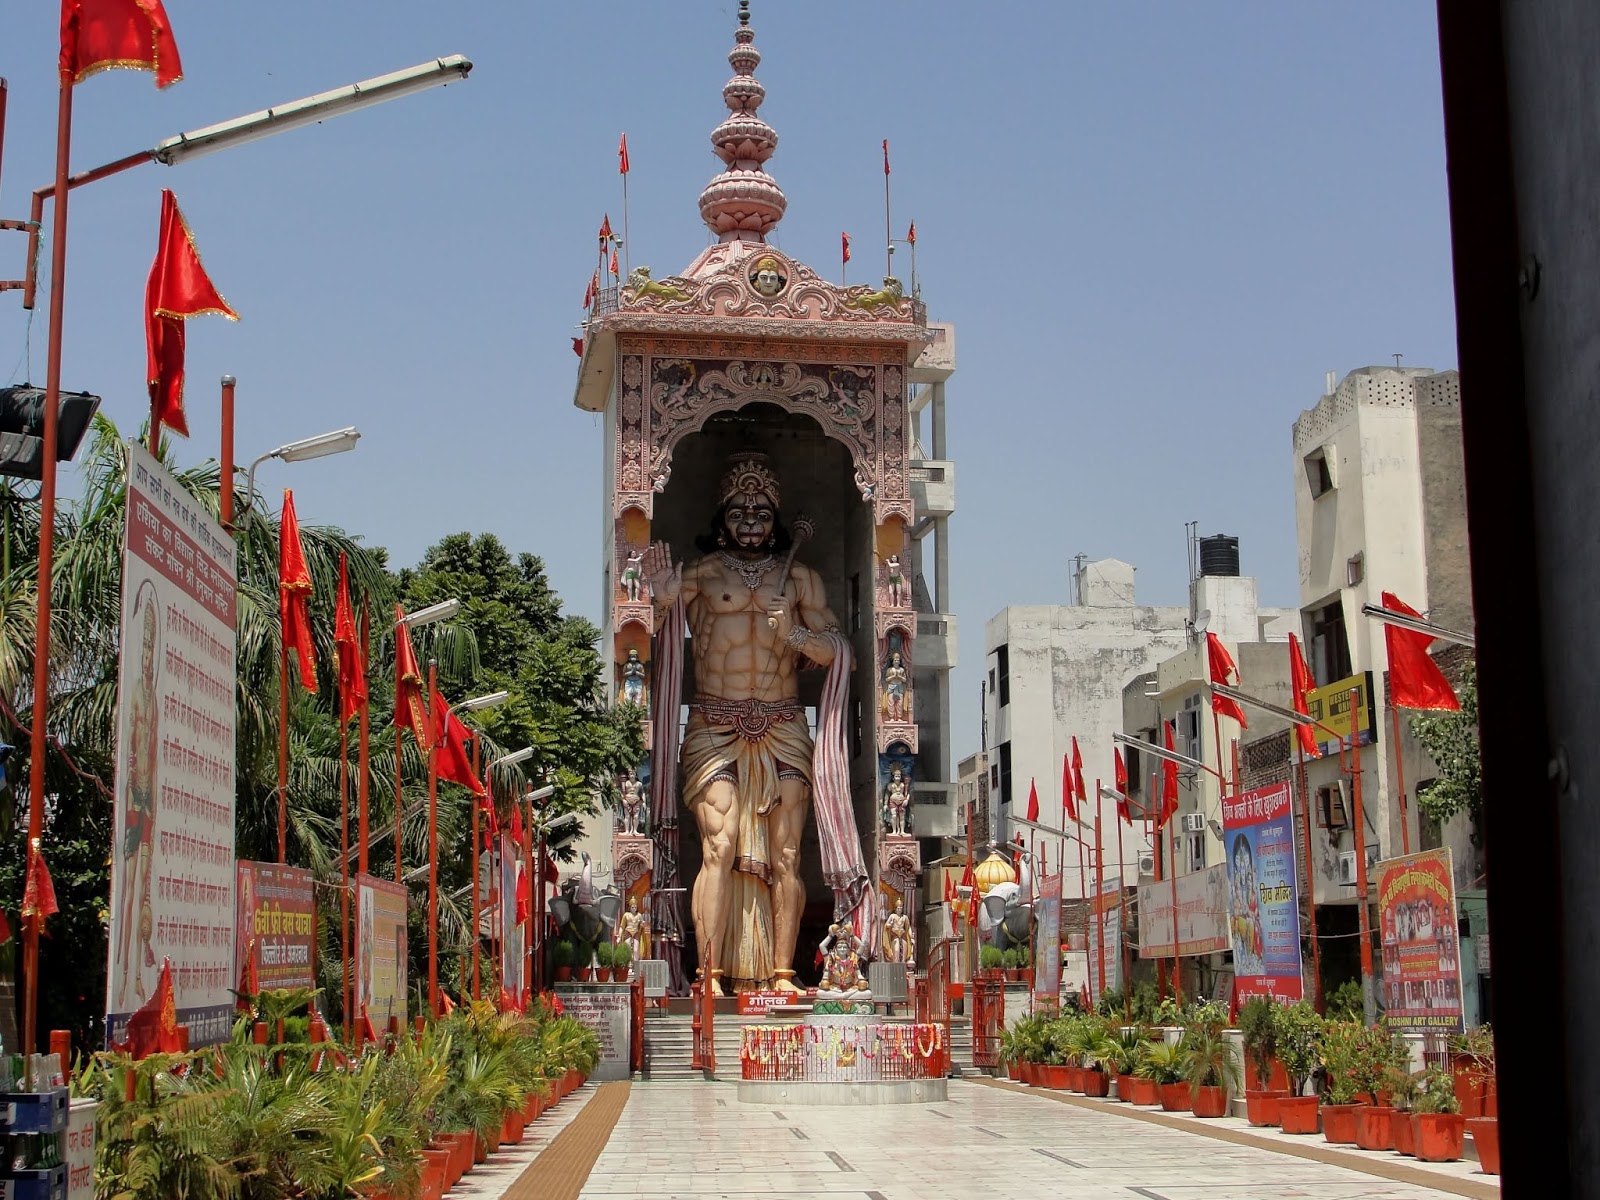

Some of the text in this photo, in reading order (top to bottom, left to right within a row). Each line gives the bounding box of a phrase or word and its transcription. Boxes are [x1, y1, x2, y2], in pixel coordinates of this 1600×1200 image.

[136, 462, 148, 488] आप
[136, 500, 160, 535] एशिया
[162, 520, 172, 546] का
[174, 531, 194, 565] विशाल
[145, 534, 164, 563] संकट
[167, 549, 184, 579] मोचन
[186, 563, 194, 588] श्री
[749, 994, 788, 1006] गोलक
[1388, 1016, 1459, 1026] ROSHNI ART GALLERY
